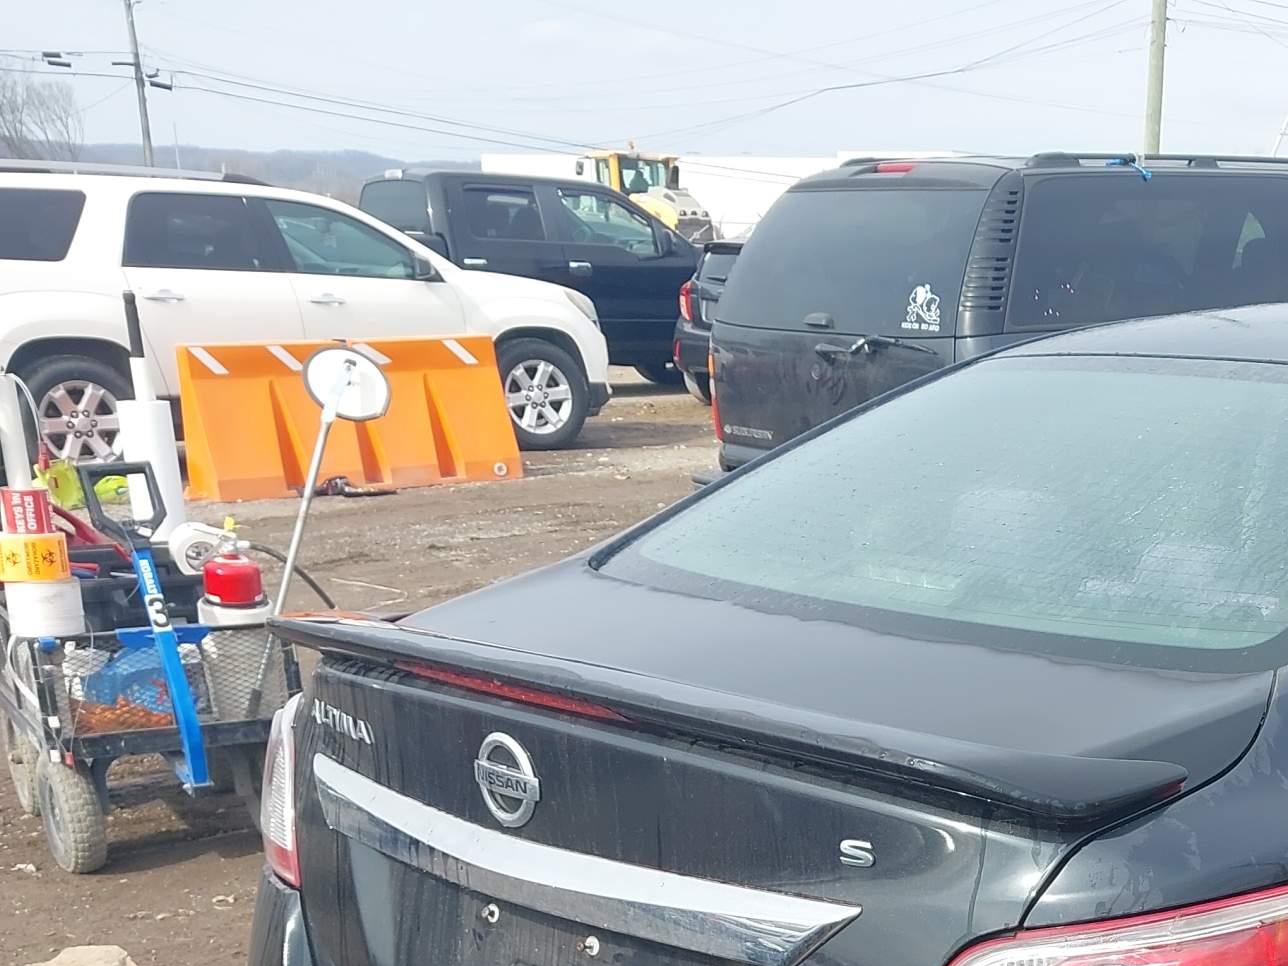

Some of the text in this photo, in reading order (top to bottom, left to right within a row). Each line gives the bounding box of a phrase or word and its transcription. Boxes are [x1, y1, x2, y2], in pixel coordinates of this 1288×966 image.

[11, 492, 26, 533] KEYS IN
[23, 495, 37, 530] OFFICE
[148, 597, 170, 627] 3
[311, 698, 375, 744] ALTIMA
[479, 765, 527, 793] NISSAN
[840, 839, 874, 867] S
